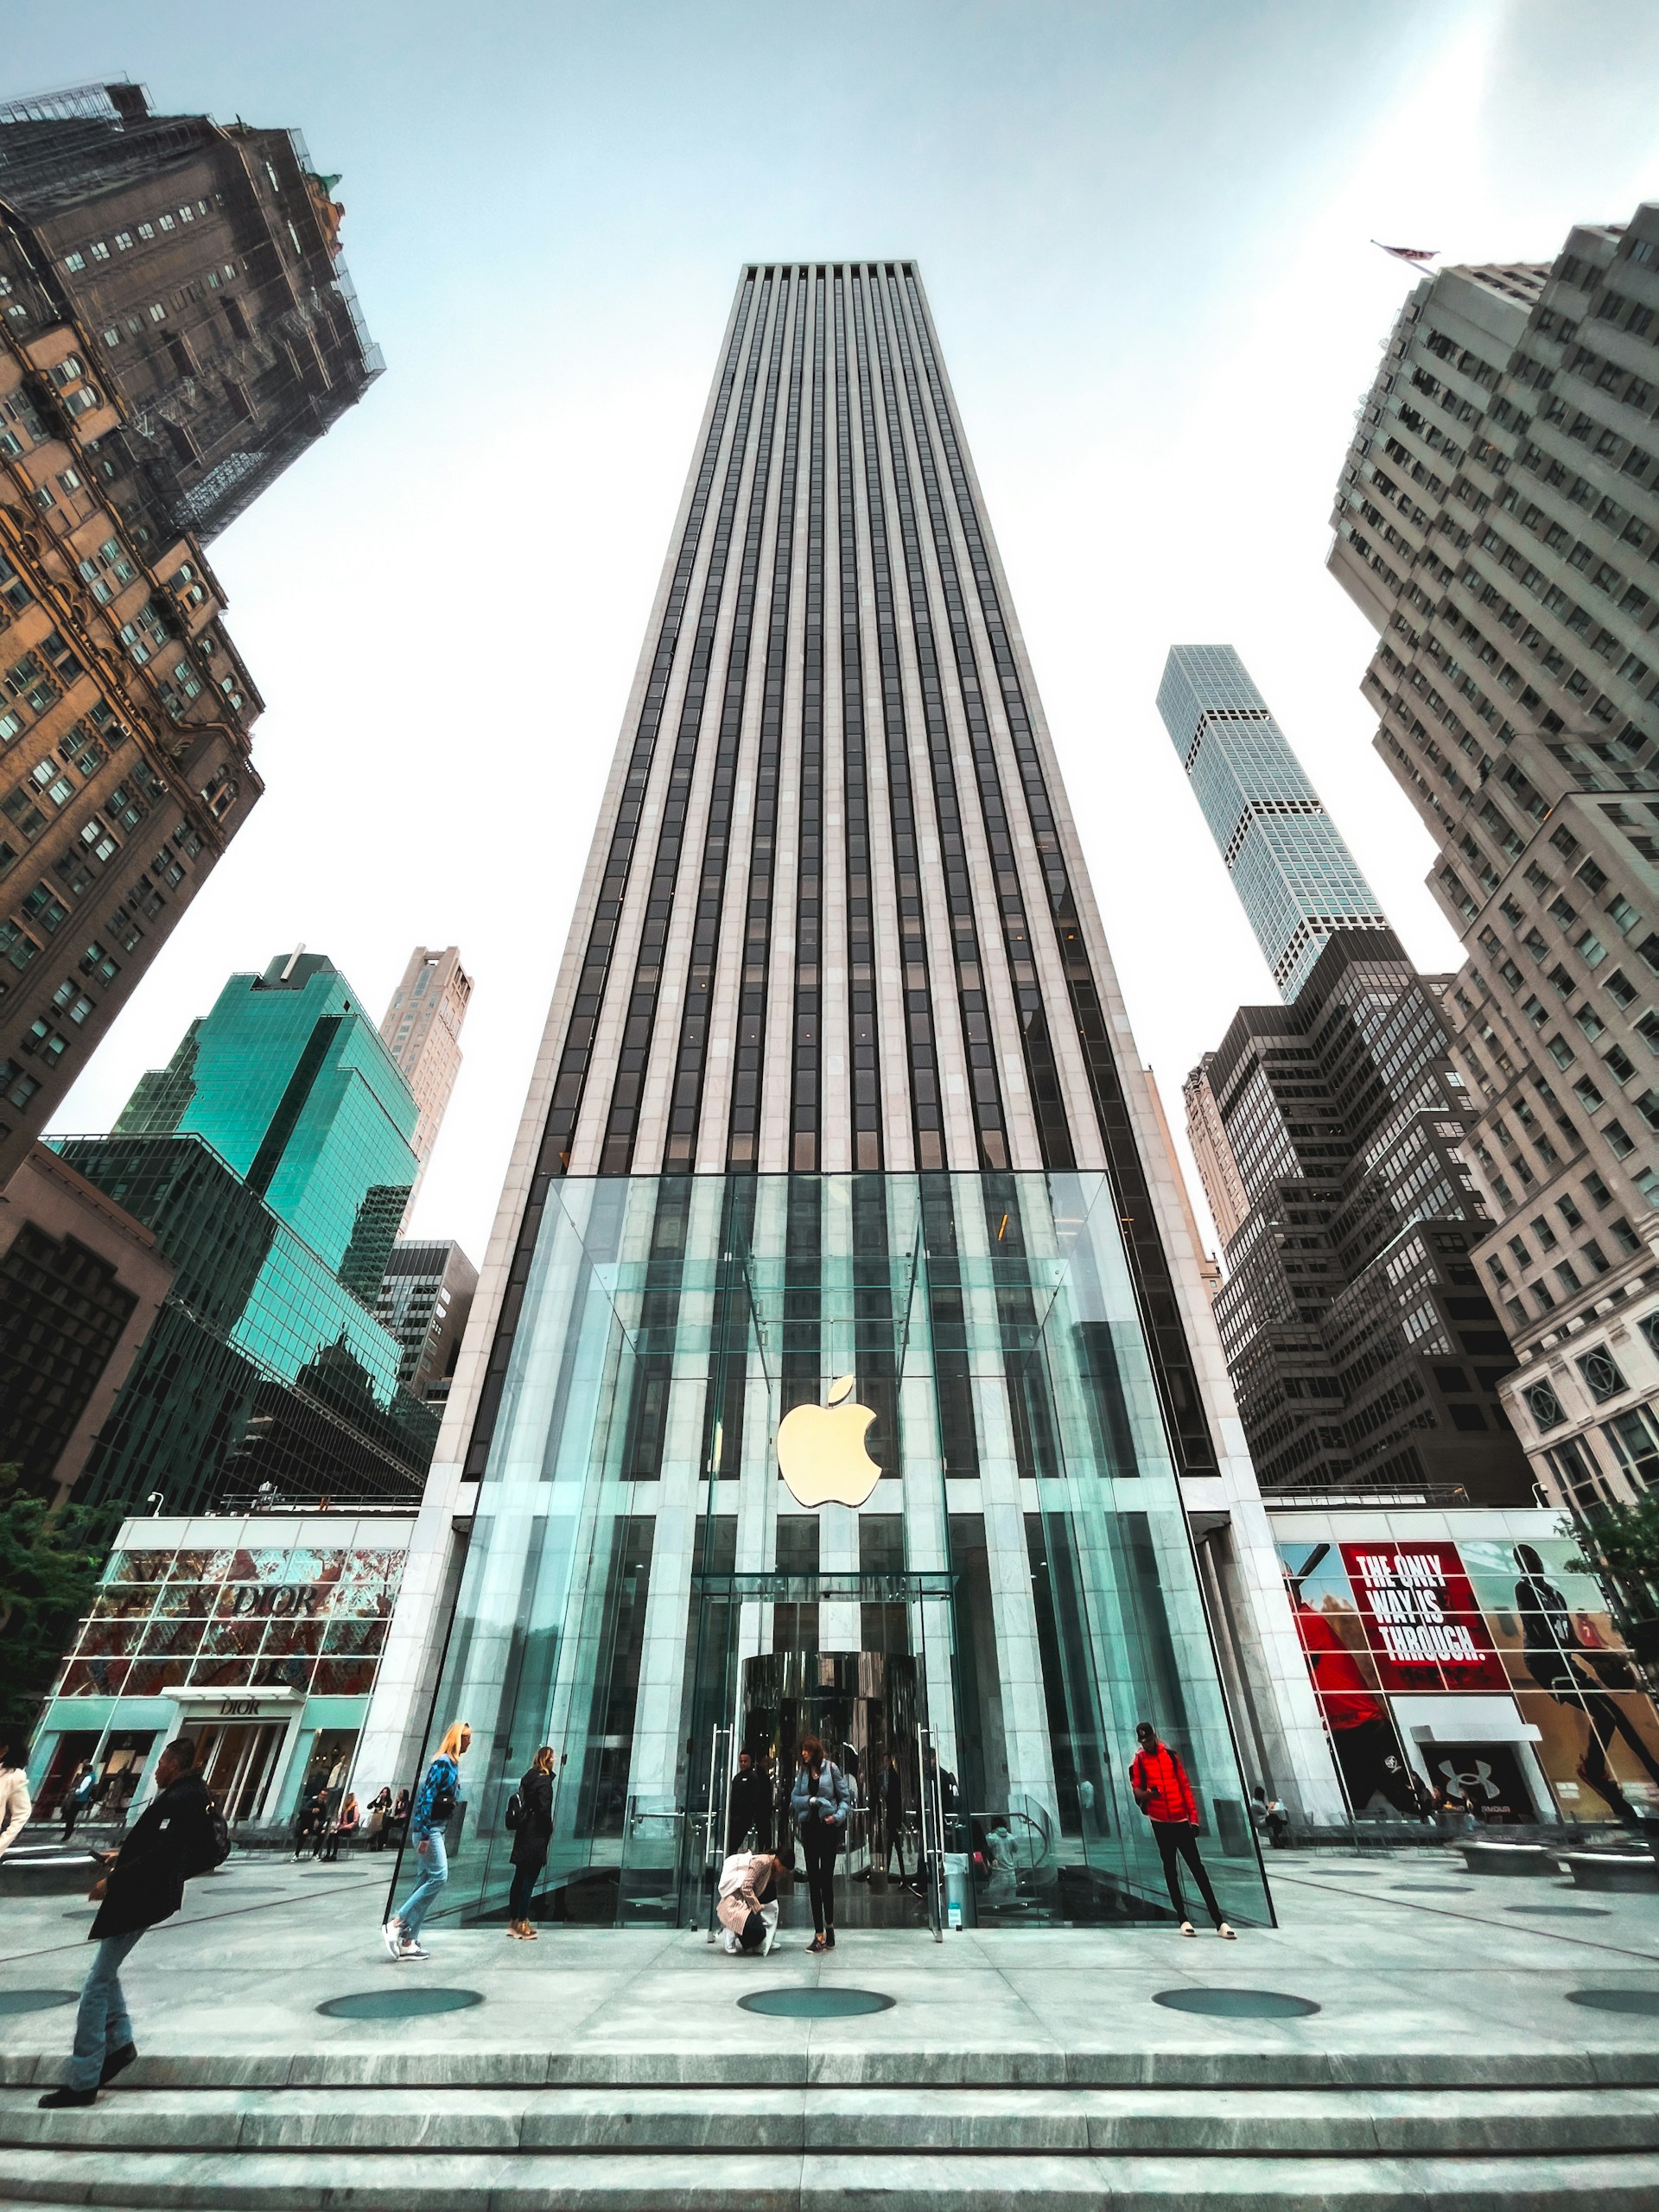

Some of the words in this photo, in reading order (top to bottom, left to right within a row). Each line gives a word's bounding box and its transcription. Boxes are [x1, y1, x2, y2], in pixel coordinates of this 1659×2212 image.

[1356, 1555, 1396, 1587] THE
[1394, 1554, 1446, 1587] ONLY
[232, 1586, 318, 1615] DIOR
[1365, 1590, 1417, 1624] WAY
[1415, 1590, 1444, 1624] IS
[1378, 1626, 1485, 1662] THROUGH.
[219, 1700, 260, 1715] DIOR
[1478, 1804, 1511, 1813] RMOUR
